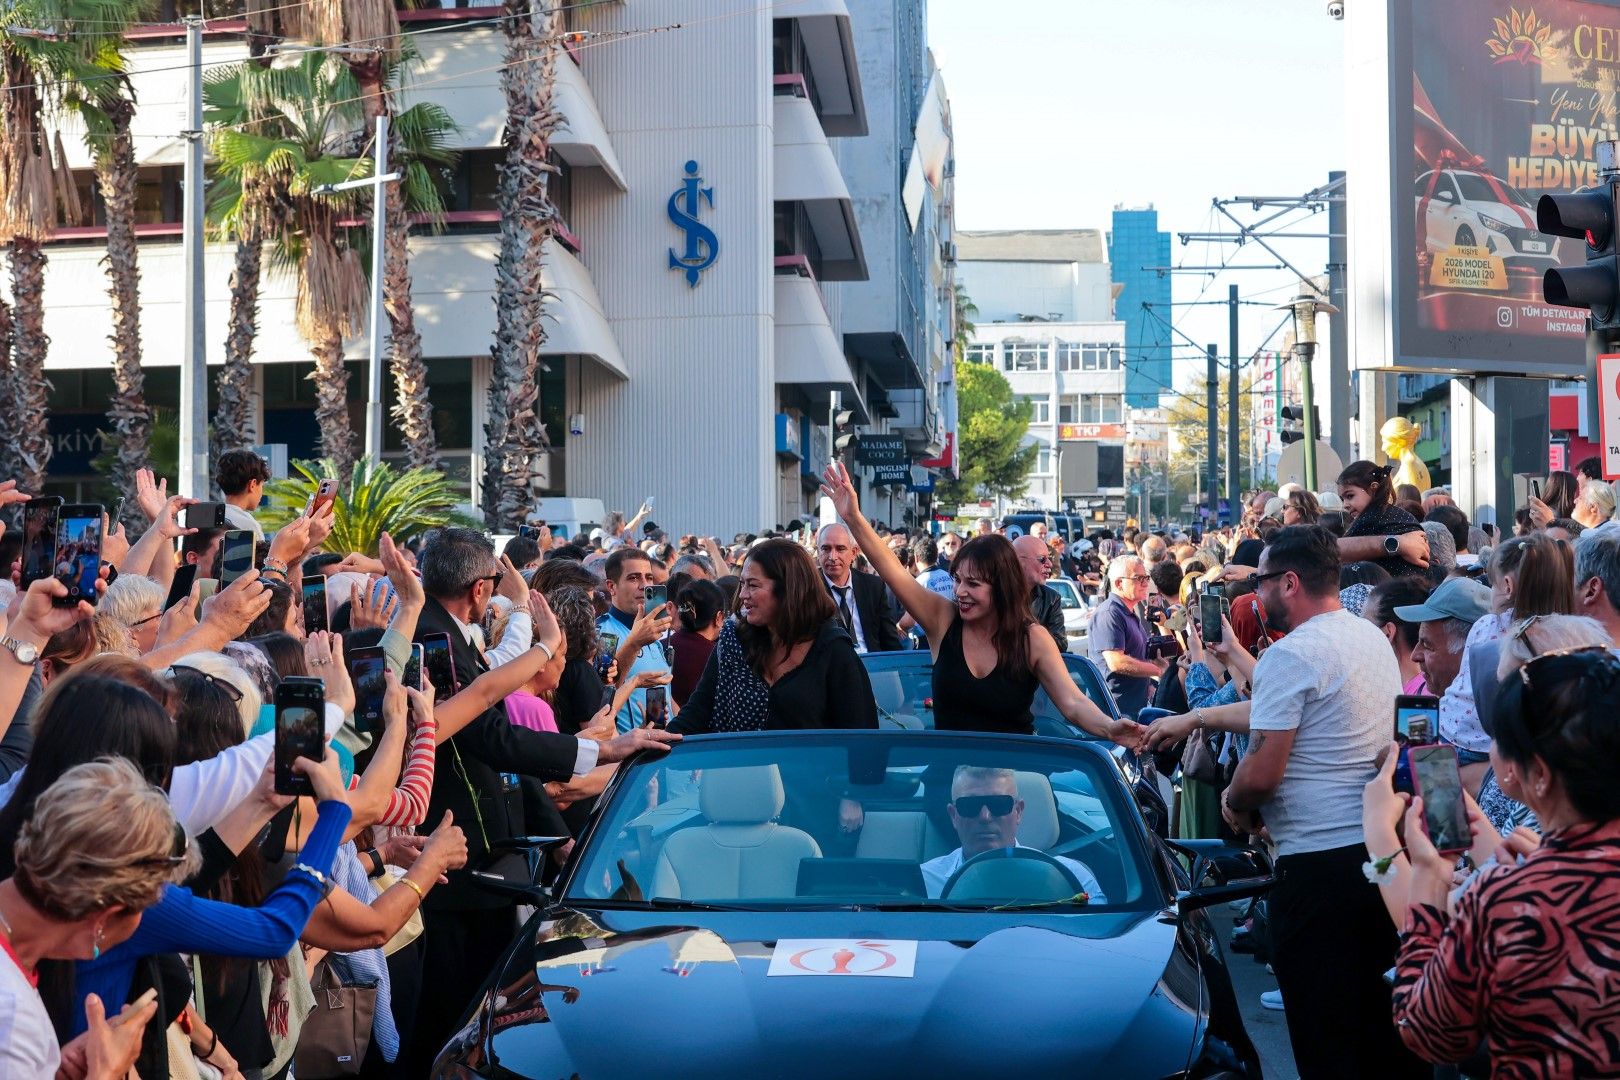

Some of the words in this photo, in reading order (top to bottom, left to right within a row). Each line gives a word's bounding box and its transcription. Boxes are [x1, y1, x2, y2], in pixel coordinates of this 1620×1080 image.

[1550, 87, 1584, 122] Yeni
[1445, 258, 1464, 267] 2026
[1465, 259, 1492, 269] MODEL
[1442, 267, 1481, 279] HYUNDAI
[1521, 305, 1540, 317] TÜM
[1074, 426, 1101, 436] TKP
[860, 441, 903, 450] MADAME
[868, 450, 895, 459] COCO
[876, 464, 909, 473] ENGLISH
[881, 472, 905, 480] HOME
